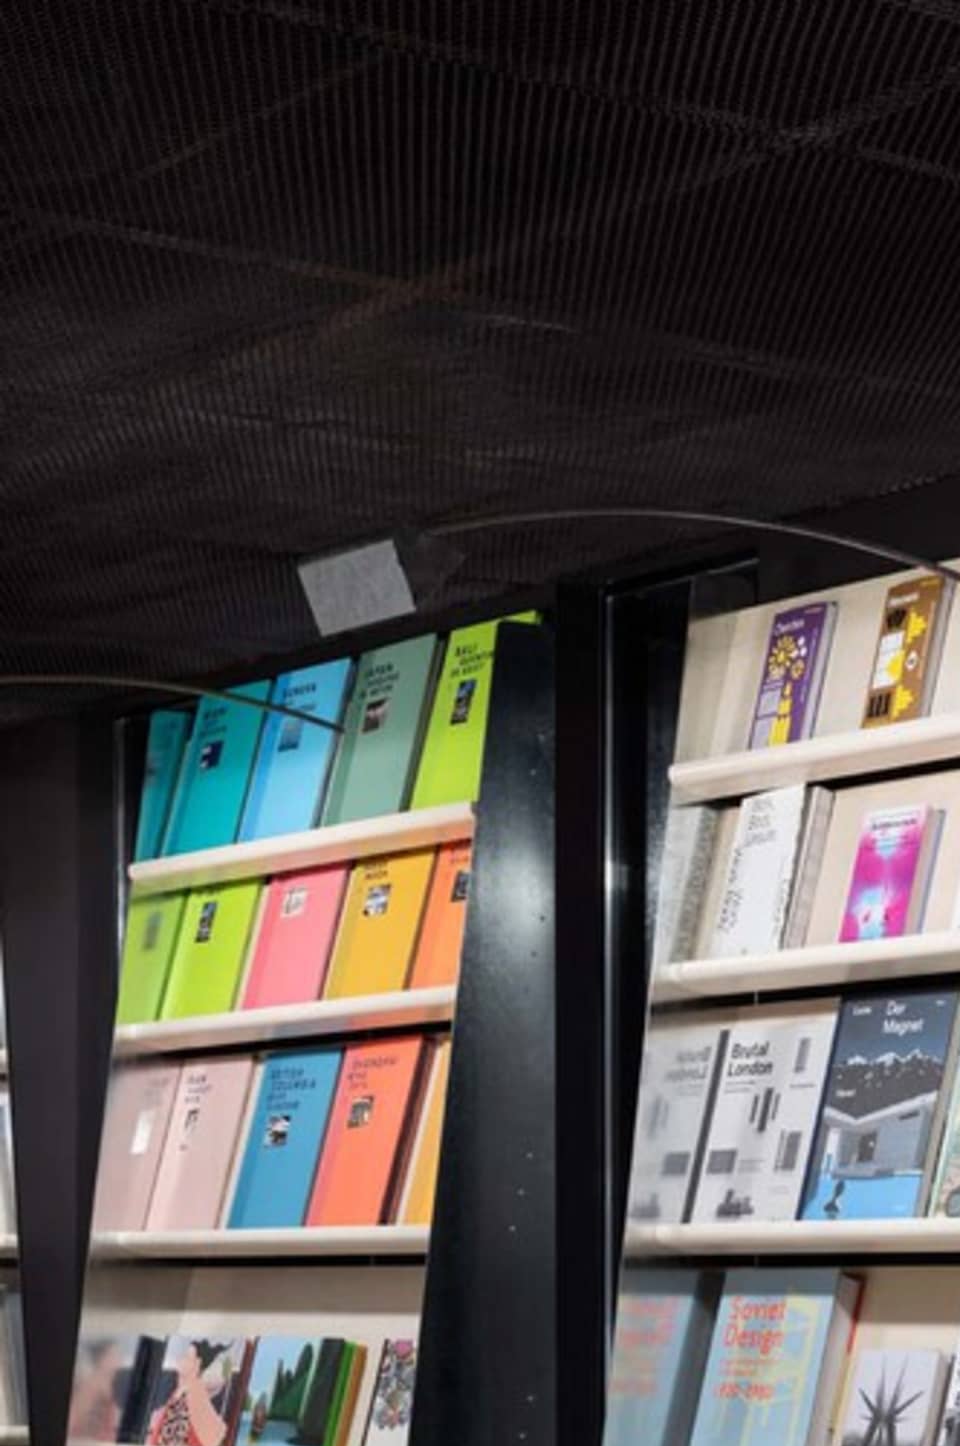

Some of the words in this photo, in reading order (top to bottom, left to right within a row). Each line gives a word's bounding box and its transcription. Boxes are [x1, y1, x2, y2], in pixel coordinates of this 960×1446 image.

[730, 1041, 770, 1060] Brutal
[726, 1060, 773, 1078] London
[722, 1322, 785, 1357] Design
